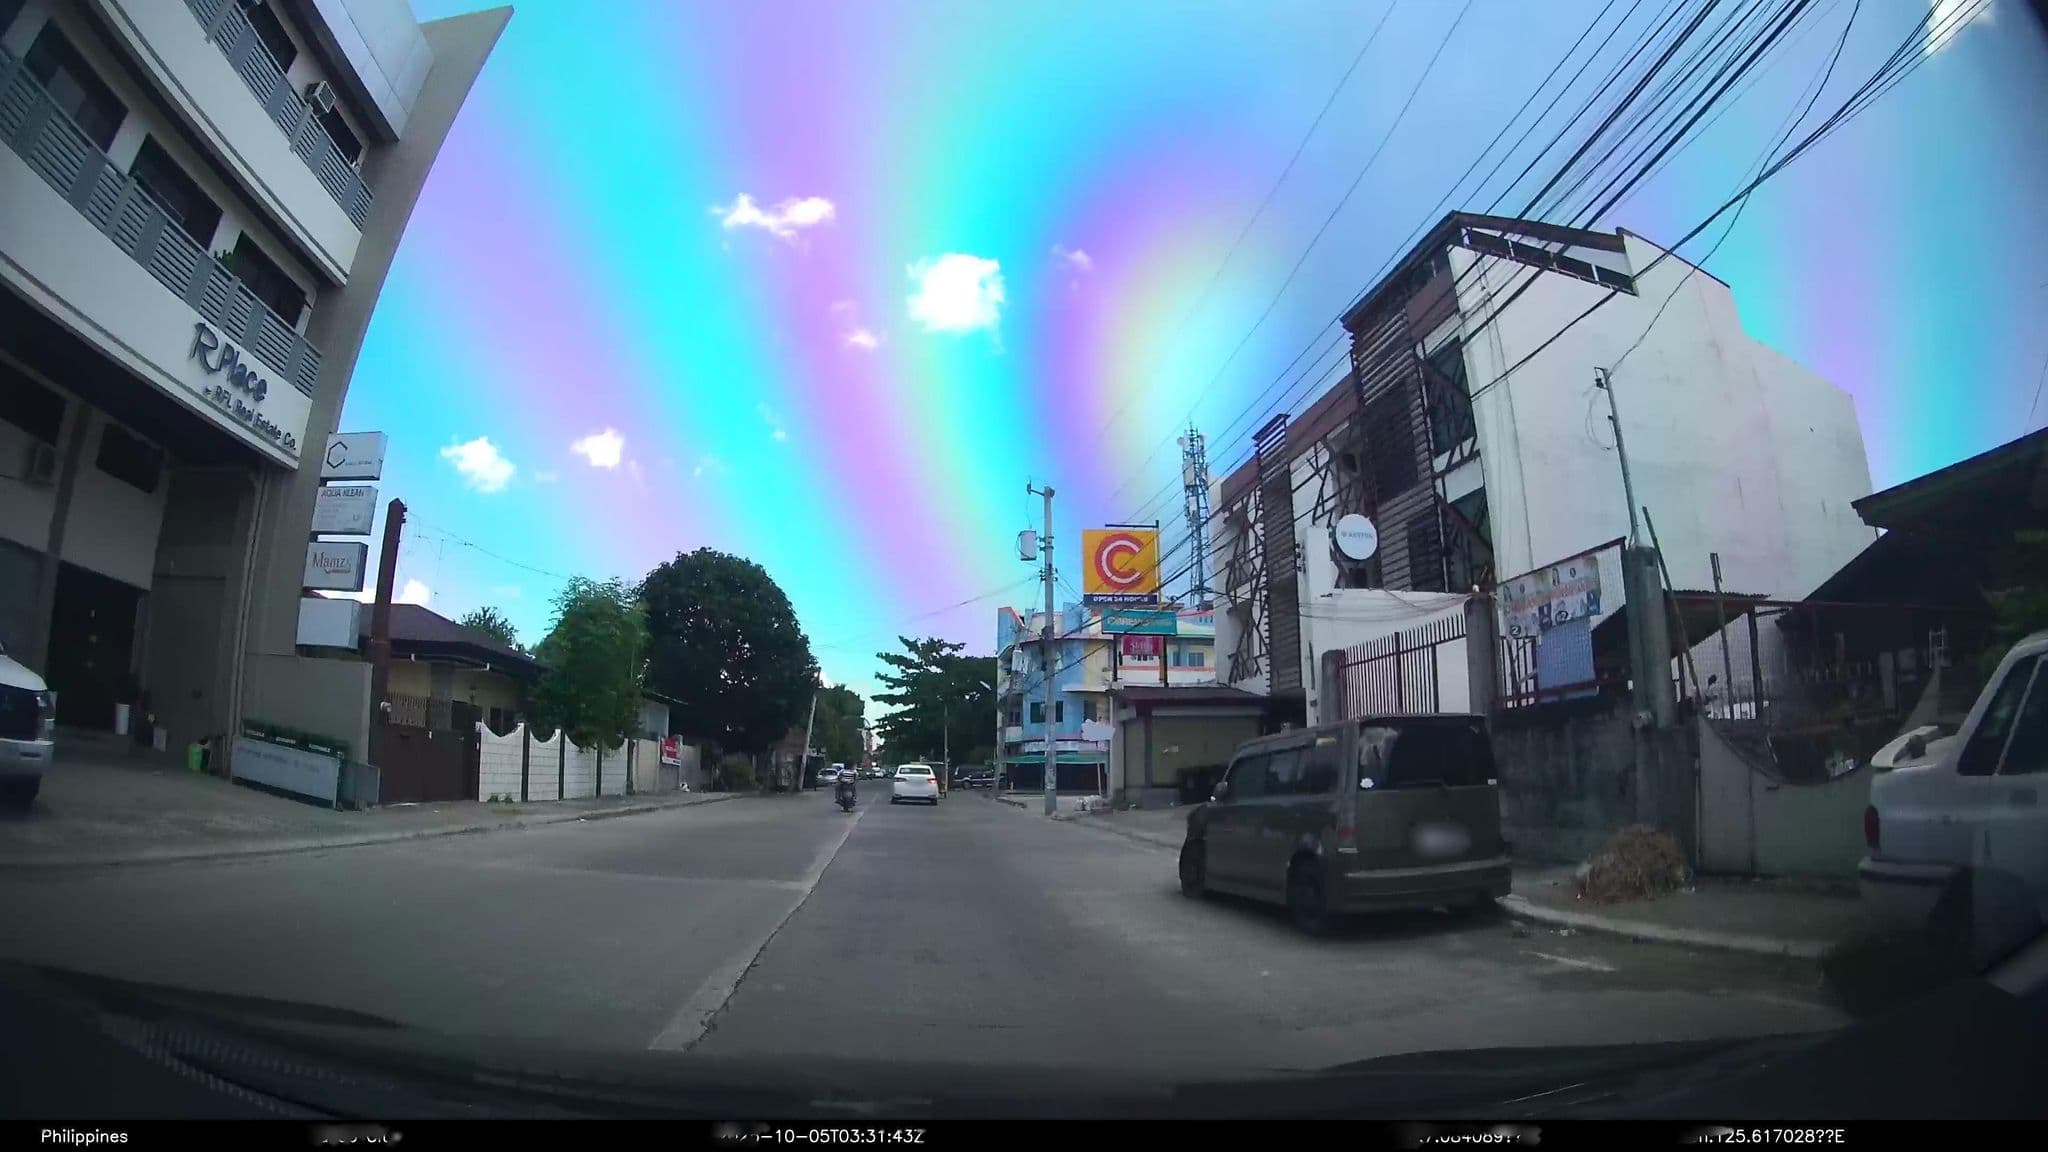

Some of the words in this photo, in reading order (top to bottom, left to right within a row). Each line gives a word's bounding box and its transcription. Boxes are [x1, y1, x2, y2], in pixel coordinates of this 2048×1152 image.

[190, 322, 220, 373] R
[218, 343, 267, 402] Place
[254, 413, 282, 440] Estate
[283, 432, 297, 450] Co.
